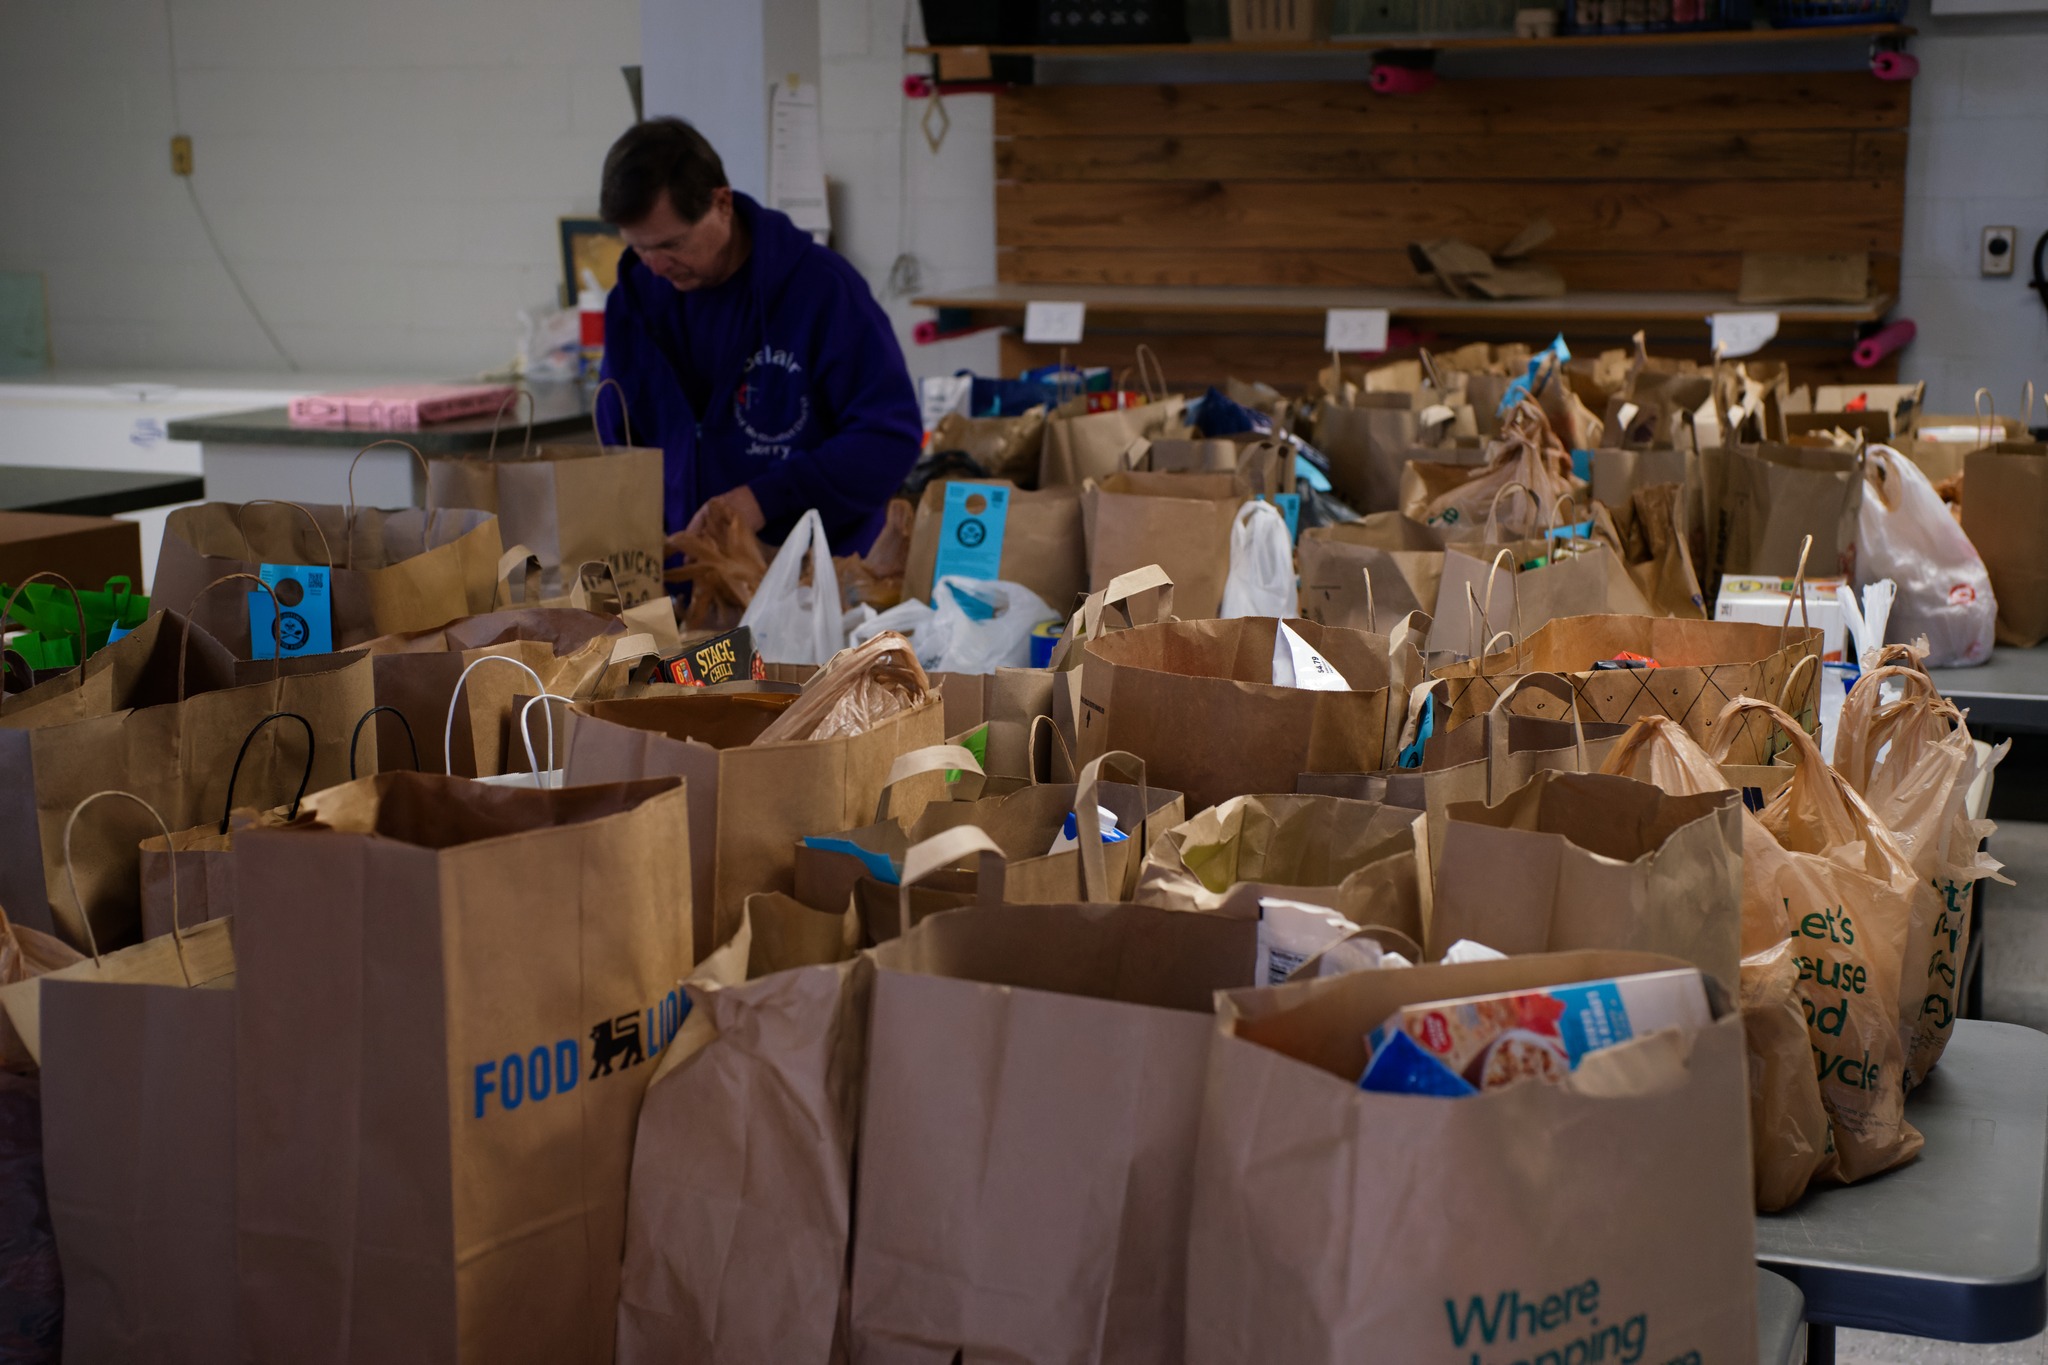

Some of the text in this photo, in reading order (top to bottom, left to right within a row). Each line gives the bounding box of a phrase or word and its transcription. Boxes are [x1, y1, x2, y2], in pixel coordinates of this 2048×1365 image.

[745, 441, 792, 460] Jerry
[695, 638, 737, 678] STAGG
[709, 662, 734, 683] CHILI
[1802, 998, 1848, 1037] nd
[475, 1039, 579, 1119] FOOD
[1811, 1044, 1880, 1091] ycle
[1446, 1278, 1600, 1347] Where
